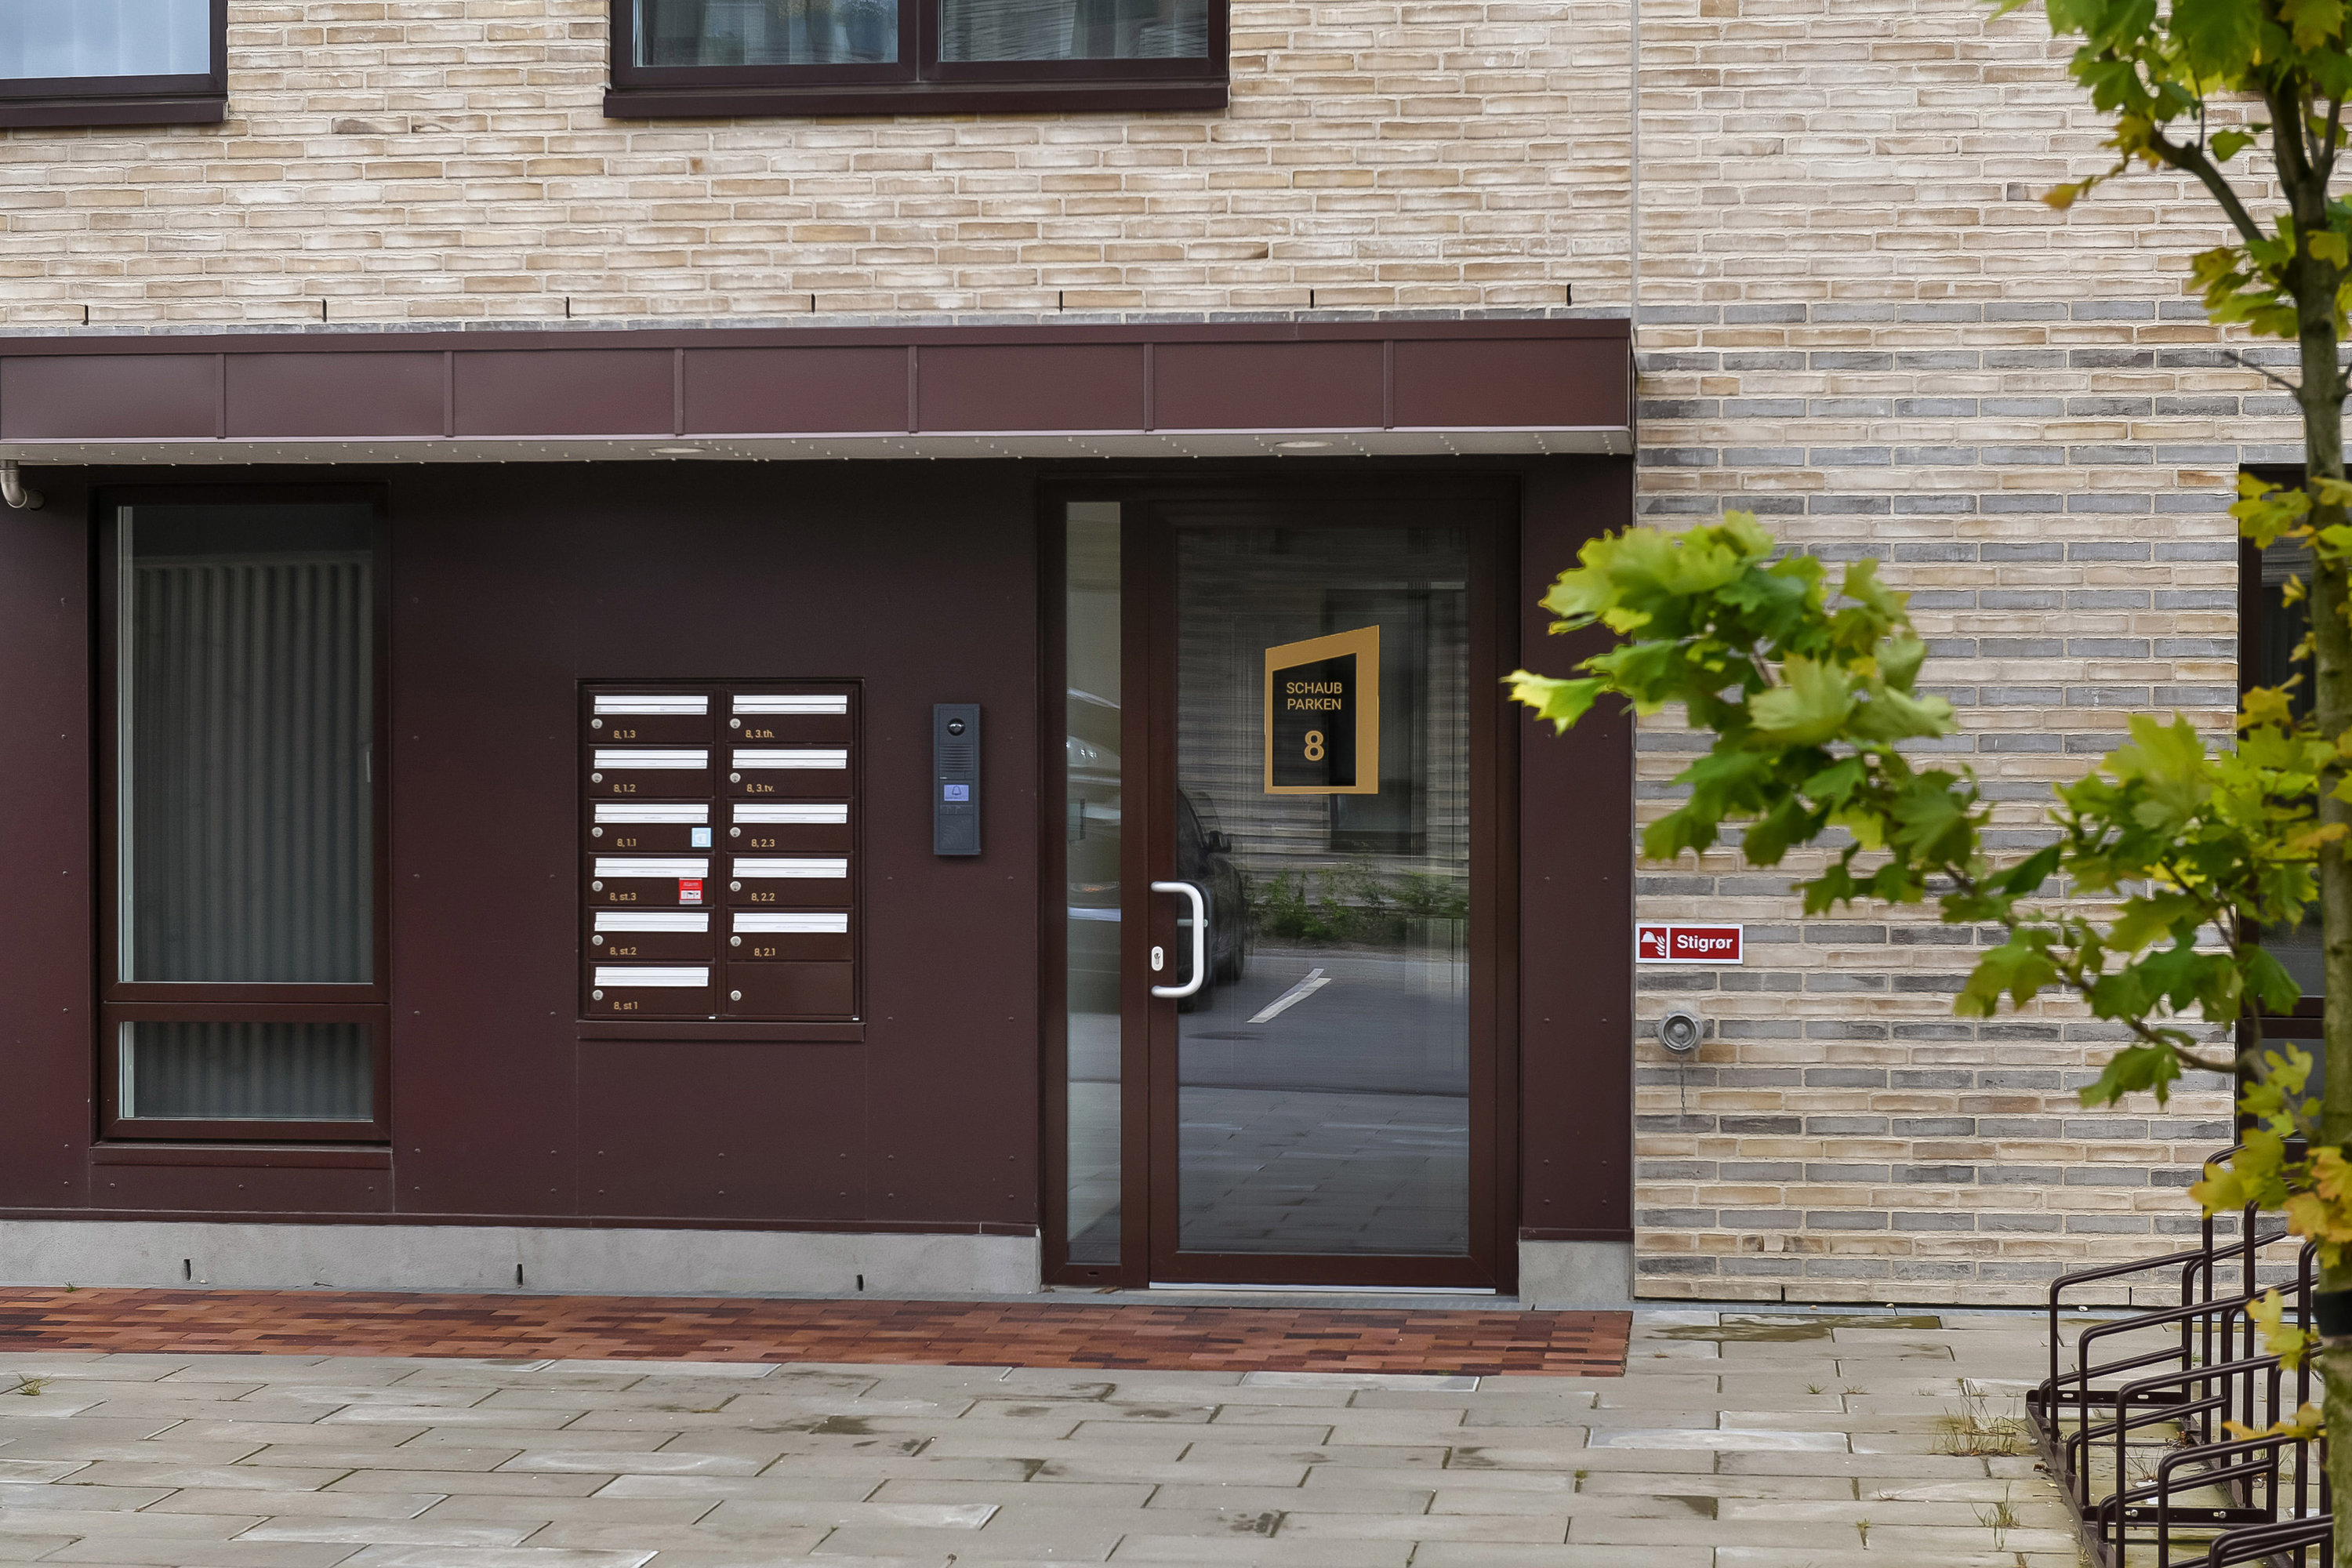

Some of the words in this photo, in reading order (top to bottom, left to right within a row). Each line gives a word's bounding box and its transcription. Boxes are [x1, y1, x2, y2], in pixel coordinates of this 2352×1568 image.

[1286, 681, 1343, 695] SCHAUB
[1287, 698, 1341, 710] PARKEN
[1304, 730, 1325, 761] 8
[1676, 935, 1733, 953] Stigrør
